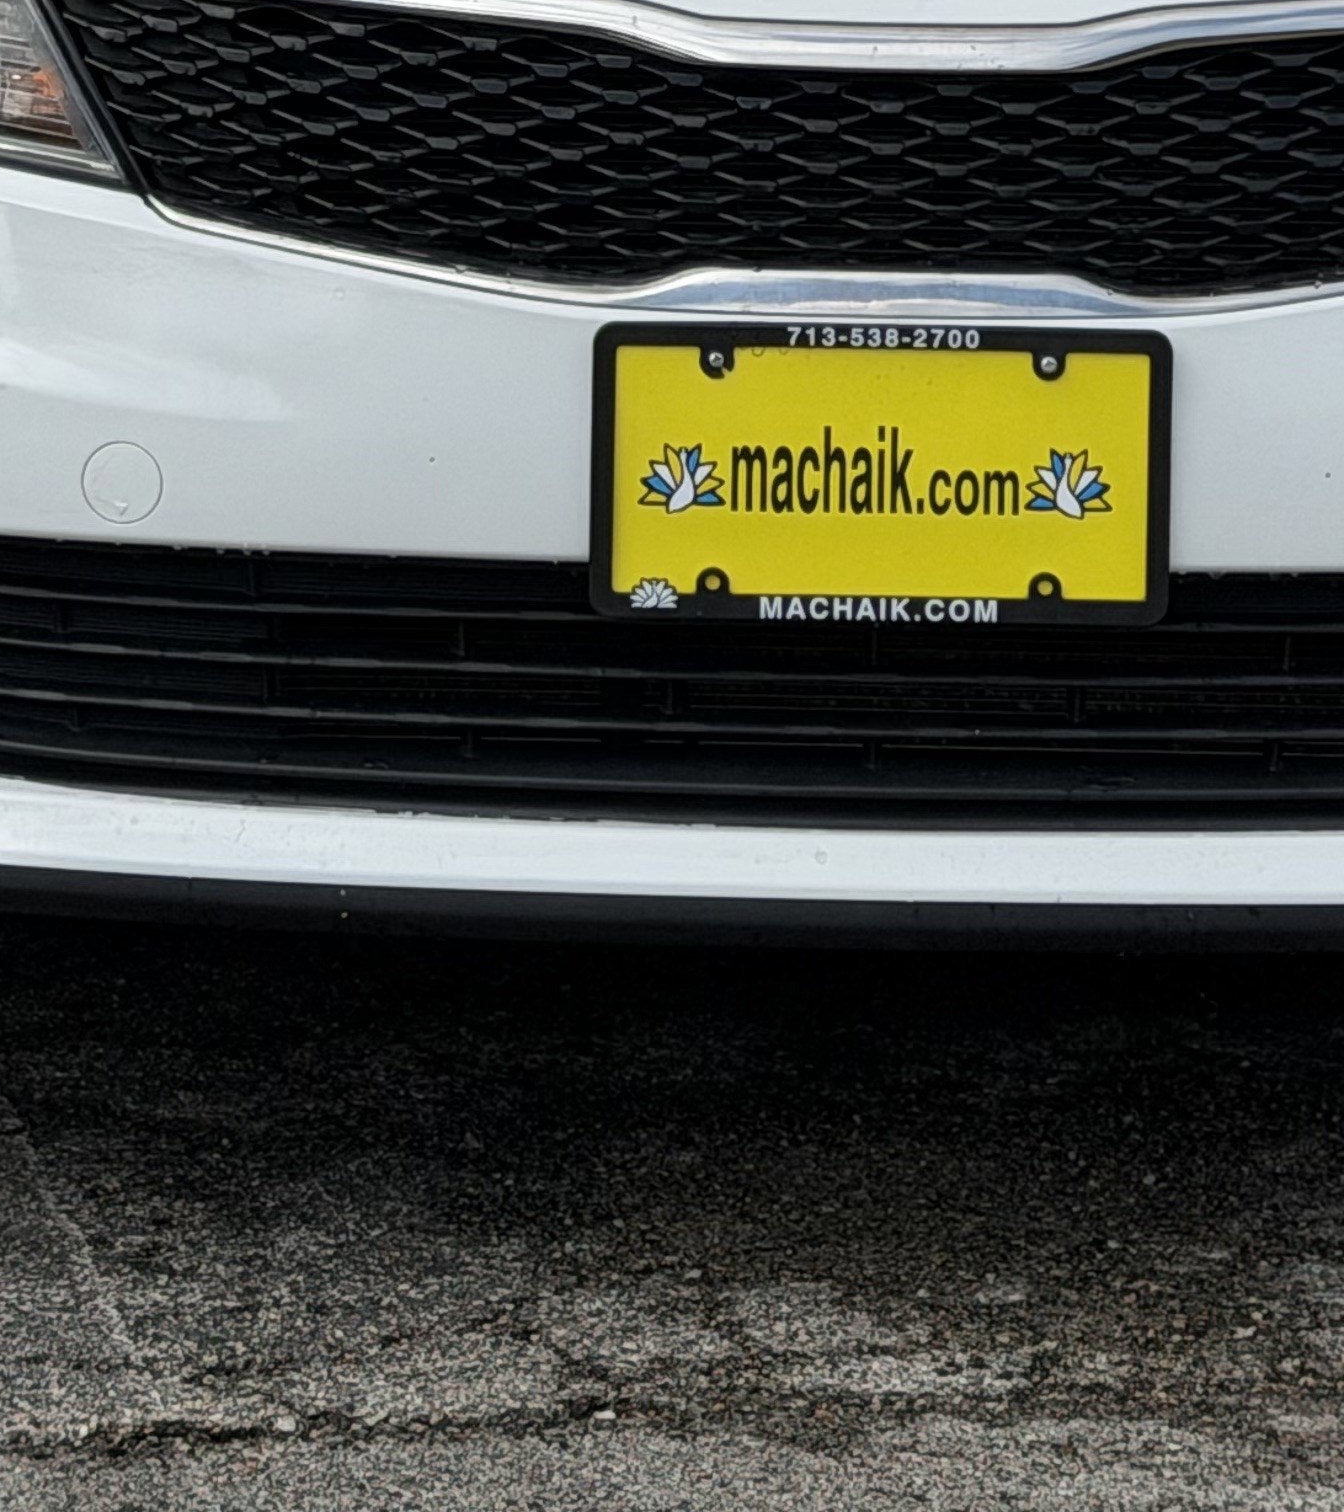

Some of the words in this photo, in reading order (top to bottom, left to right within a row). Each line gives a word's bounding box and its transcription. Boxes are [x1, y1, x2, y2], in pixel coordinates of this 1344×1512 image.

[787, 327, 981, 349] 713-538-2700
[730, 426, 1020, 516] machaik.com
[759, 596, 999, 624] MACHAIK.COM
